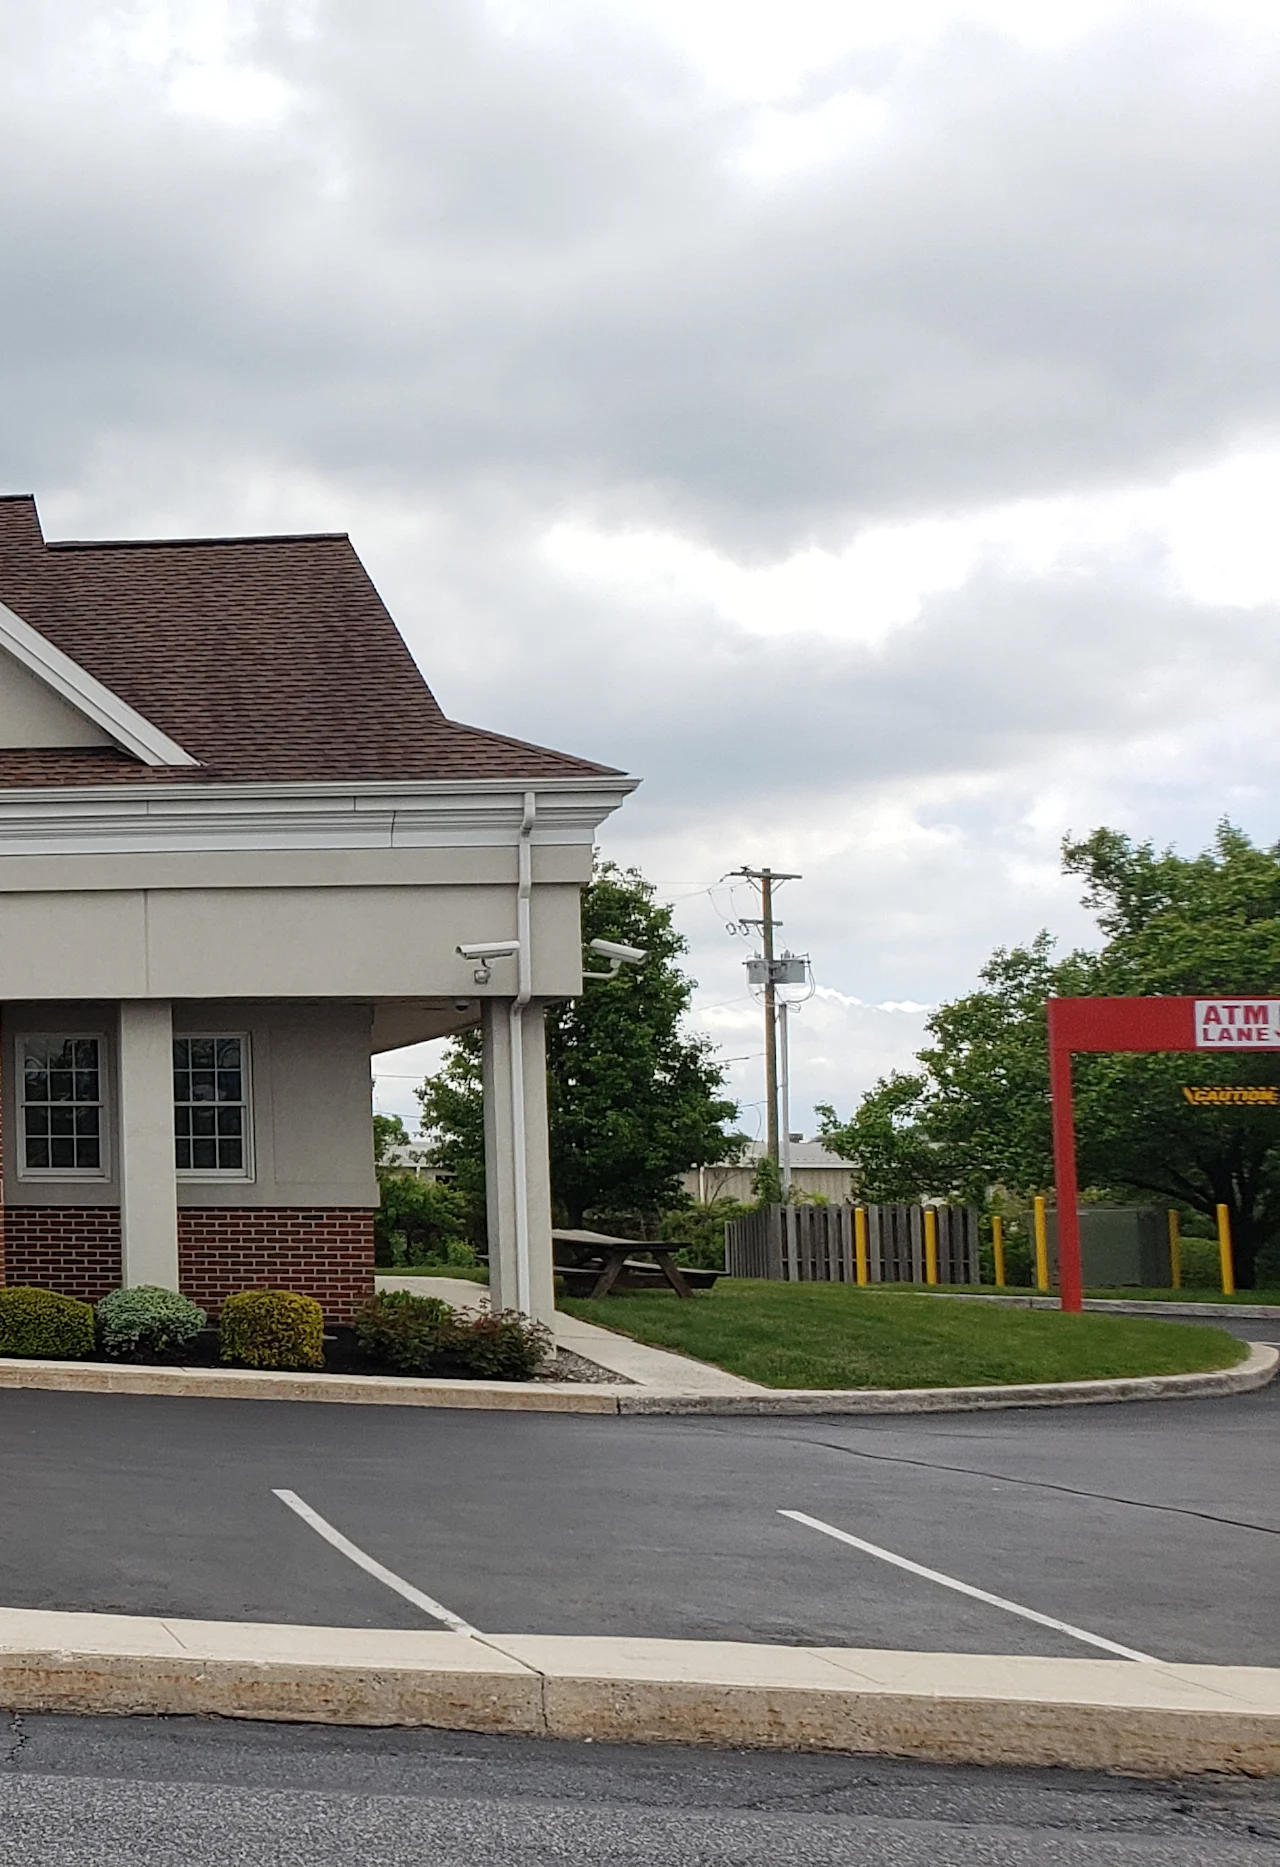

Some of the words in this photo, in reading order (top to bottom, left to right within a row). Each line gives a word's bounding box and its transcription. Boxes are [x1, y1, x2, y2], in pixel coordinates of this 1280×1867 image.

[1203, 1005, 1269, 1025] ATM
[1203, 1027, 1270, 1041] LANE
[1194, 1090, 1276, 1101] CAUTION
